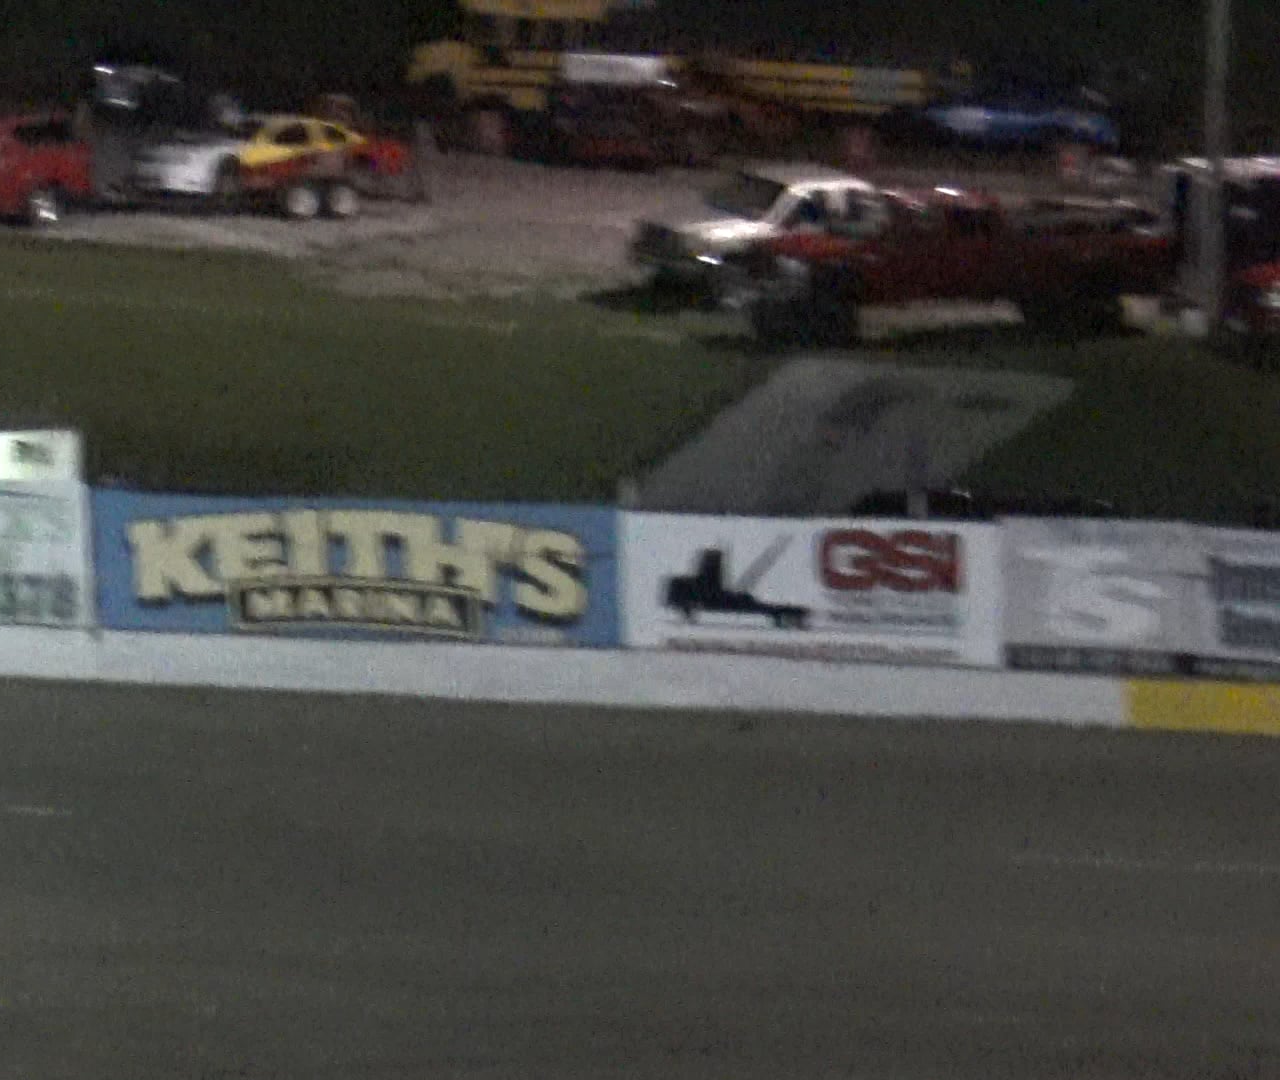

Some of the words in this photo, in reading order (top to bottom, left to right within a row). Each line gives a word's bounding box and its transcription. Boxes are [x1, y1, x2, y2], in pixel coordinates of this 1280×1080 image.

[126, 508, 590, 625] KEITH'S
[818, 526, 966, 594] GSI
[243, 586, 465, 628] MARINA
